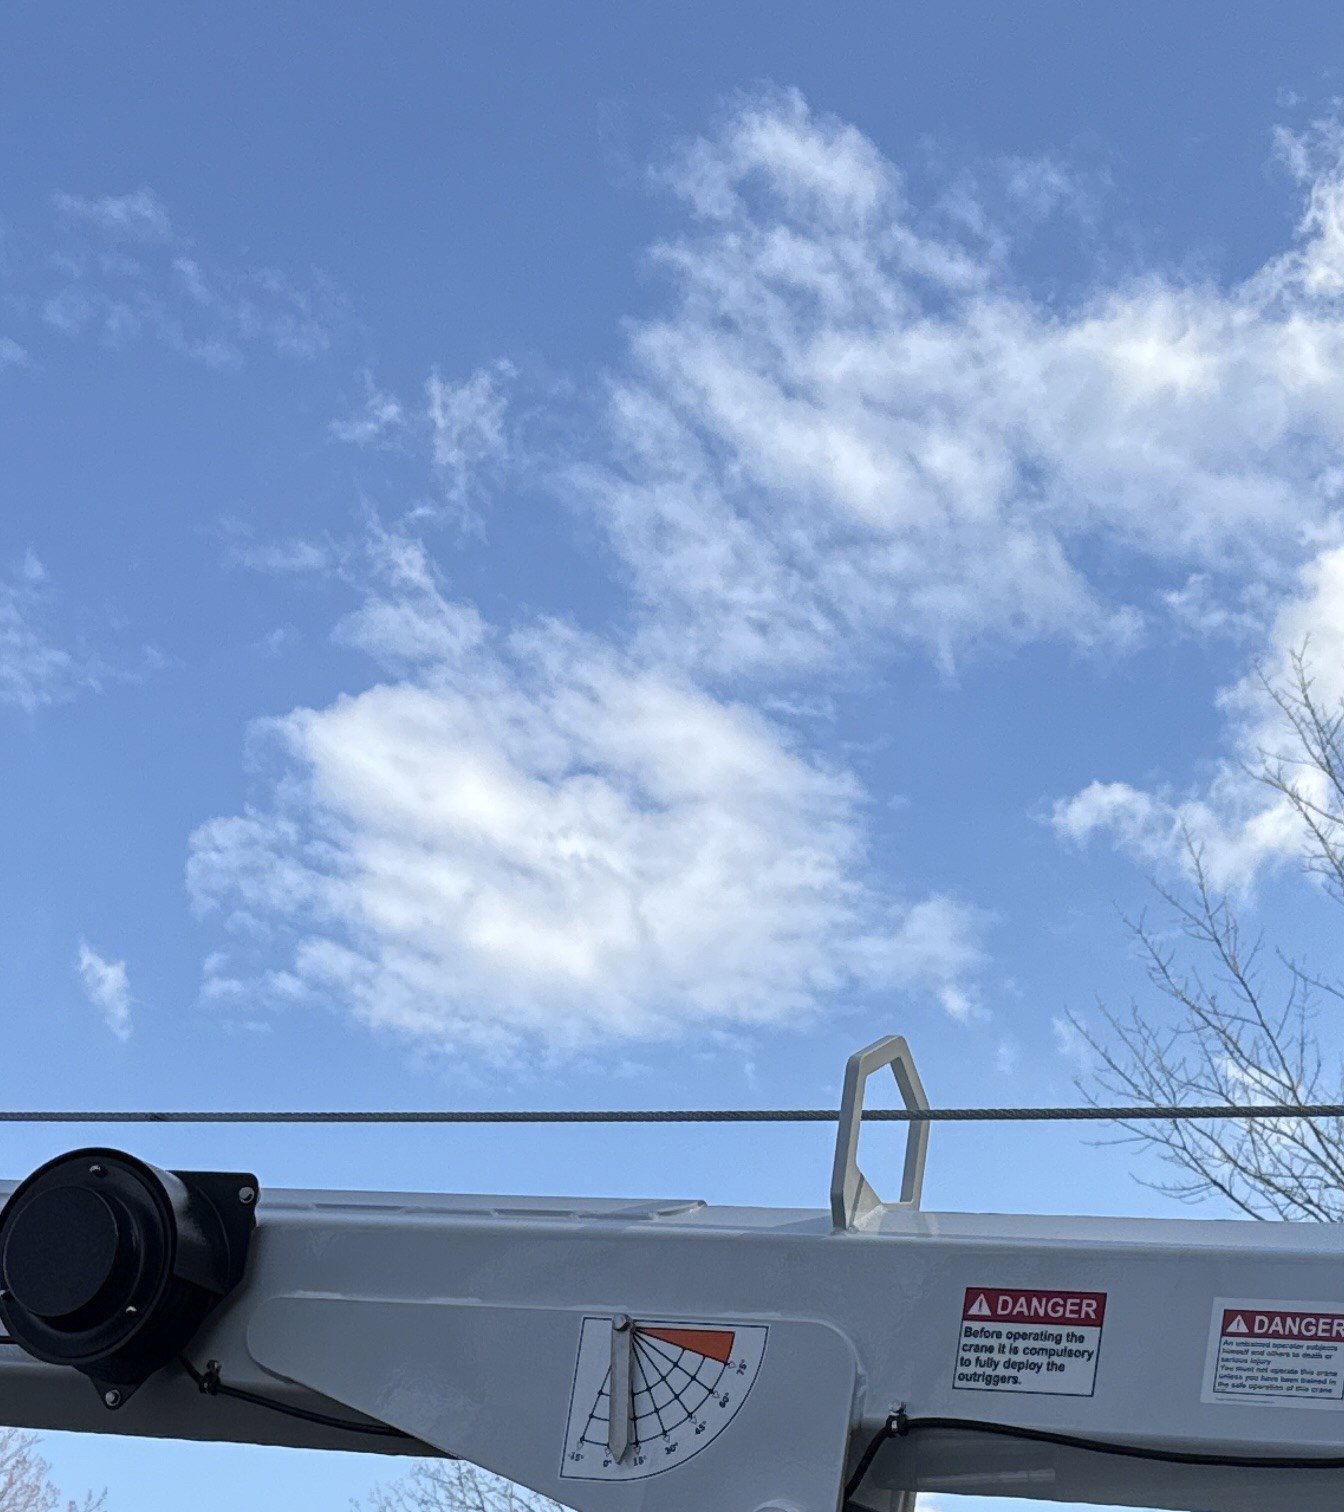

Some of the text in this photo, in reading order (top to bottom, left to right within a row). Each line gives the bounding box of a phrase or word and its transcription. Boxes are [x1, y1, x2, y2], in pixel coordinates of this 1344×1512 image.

[996, 1295, 1098, 1320] DANGER
[963, 1326, 1085, 1345] Before operating the
[961, 1342, 1094, 1362] crane it is compulsory
[959, 1356, 1065, 1374] to fully deploy the
[957, 1371, 1022, 1386] outriggers.
